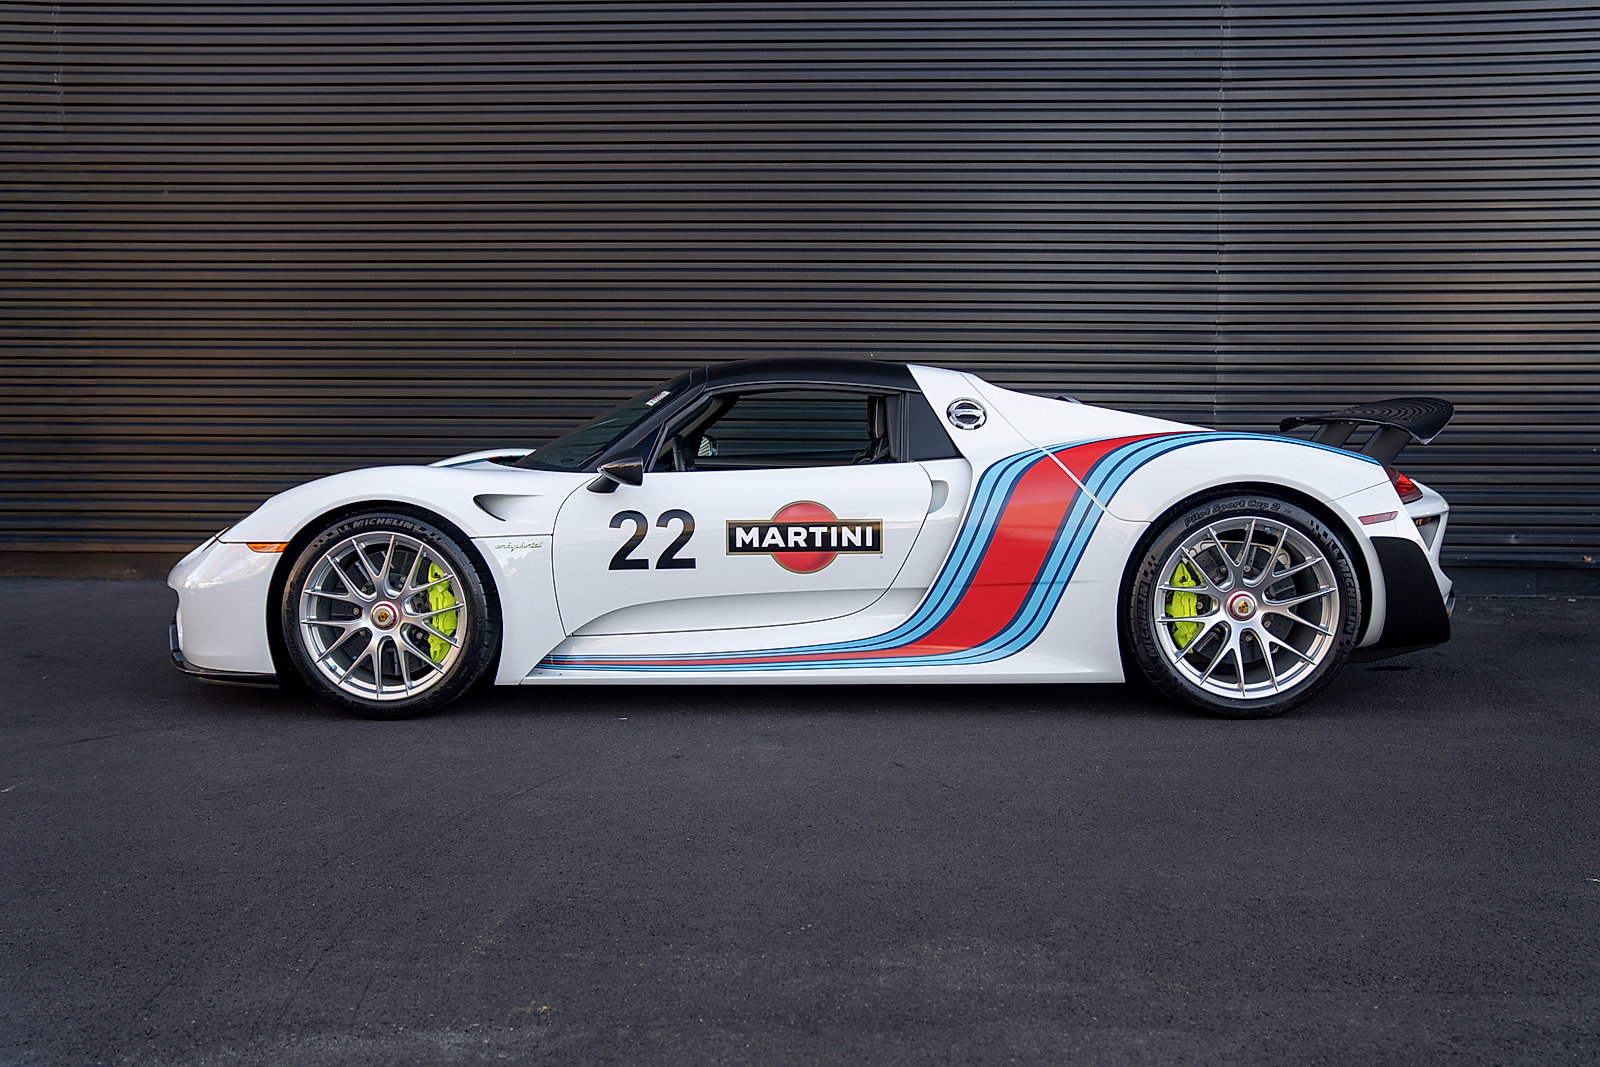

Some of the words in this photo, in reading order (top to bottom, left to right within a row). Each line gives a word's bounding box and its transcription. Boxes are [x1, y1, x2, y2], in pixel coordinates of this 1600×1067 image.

[353, 517, 415, 529] MICHELIN
[1184, 507, 1210, 527] Pilot
[1212, 500, 1246, 514] Sport
[1247, 499, 1269, 509] Cup
[1270, 503, 1281, 512] 2
[608, 509, 696, 570] 22
[735, 526, 873, 548] MARTINI
[1337, 558, 1357, 634] MICHELIN
[1137, 580, 1158, 657] MICHELIN
